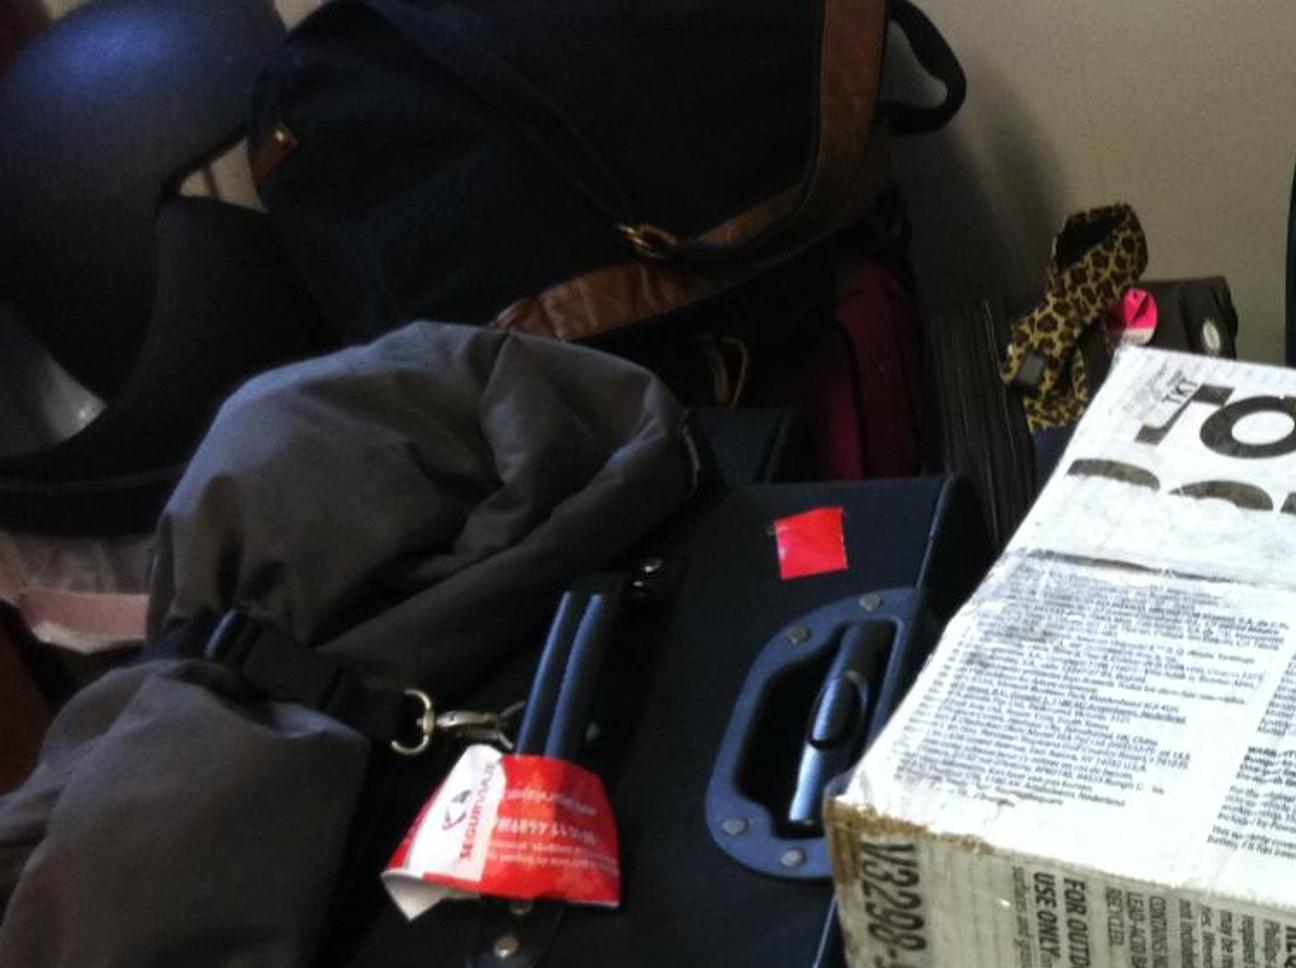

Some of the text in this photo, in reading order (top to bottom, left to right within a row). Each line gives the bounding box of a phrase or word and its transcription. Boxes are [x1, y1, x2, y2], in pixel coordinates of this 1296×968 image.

[1034, 872, 1056, 908] USE
[1064, 878, 1087, 916] FOR
[1037, 910, 1060, 958] ONLY
